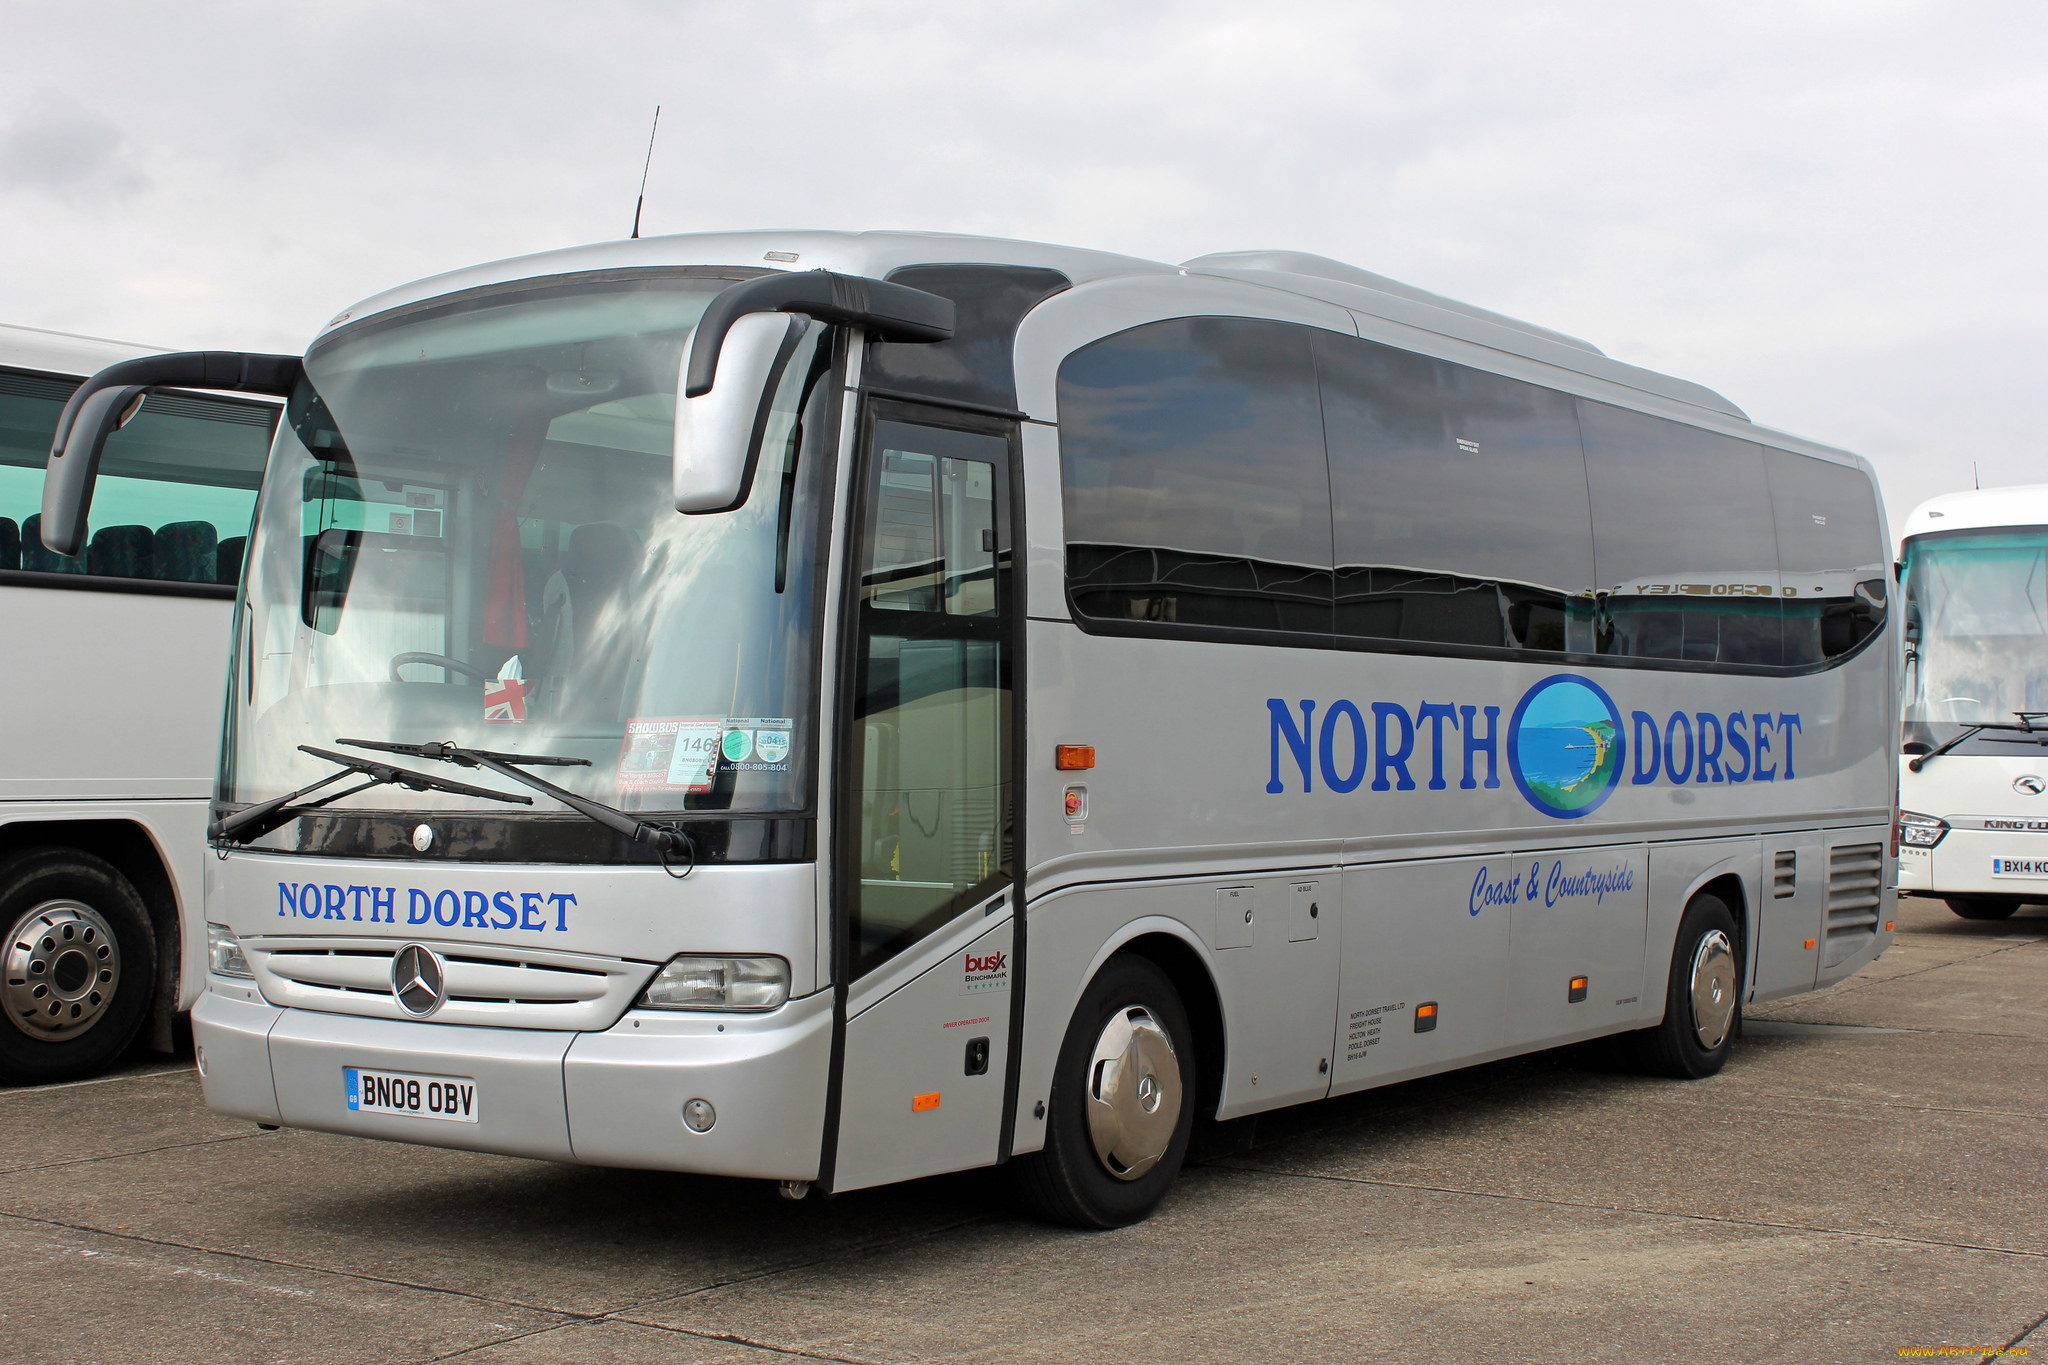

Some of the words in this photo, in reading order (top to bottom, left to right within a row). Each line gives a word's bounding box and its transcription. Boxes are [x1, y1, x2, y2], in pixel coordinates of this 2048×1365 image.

[628, 722, 679, 734] SHOWBUS
[683, 737, 713, 752] 146
[1266, 698, 1500, 794] NORTH
[1631, 710, 1802, 785] DORSET
[730, 763, 788, 772] 0800-805-804
[1984, 820, 2024, 829] KING
[2004, 860, 2032, 873] BX14
[1229, 890, 1239, 898] FUEL
[1469, 866, 1521, 917] Coast
[1526, 861, 1540, 901] &
[1545, 858, 1634, 908] Countryside
[278, 881, 396, 923] NORTH
[406, 888, 578, 932] DORSET
[965, 951, 1007, 972] busk
[965, 971, 1007, 982] BENCHMARK
[1350, 1010, 1365, 1019] NORTH
[1365, 1006, 1382, 1017] DORSET
[1382, 1003, 1397, 1013] TRAVEL
[1397, 1001, 1406, 1010] LTD
[943, 1021, 957, 1029] DRIVER
[958, 1018, 978, 1027] OPERATED
[1350, 1020, 1367, 1030] FREIGHT
[1367, 1016, 1382, 1026] HOUSE
[1348, 1030, 1366, 1040] HOLTON
[1366, 1027, 1381, 1036] HEATH
[1363, 1037, 1380, 1048] DORSET
[349, 1094, 358, 1104] GB
[363, 1075, 421, 1111] BN08
[428, 1081, 474, 1116] OBV
